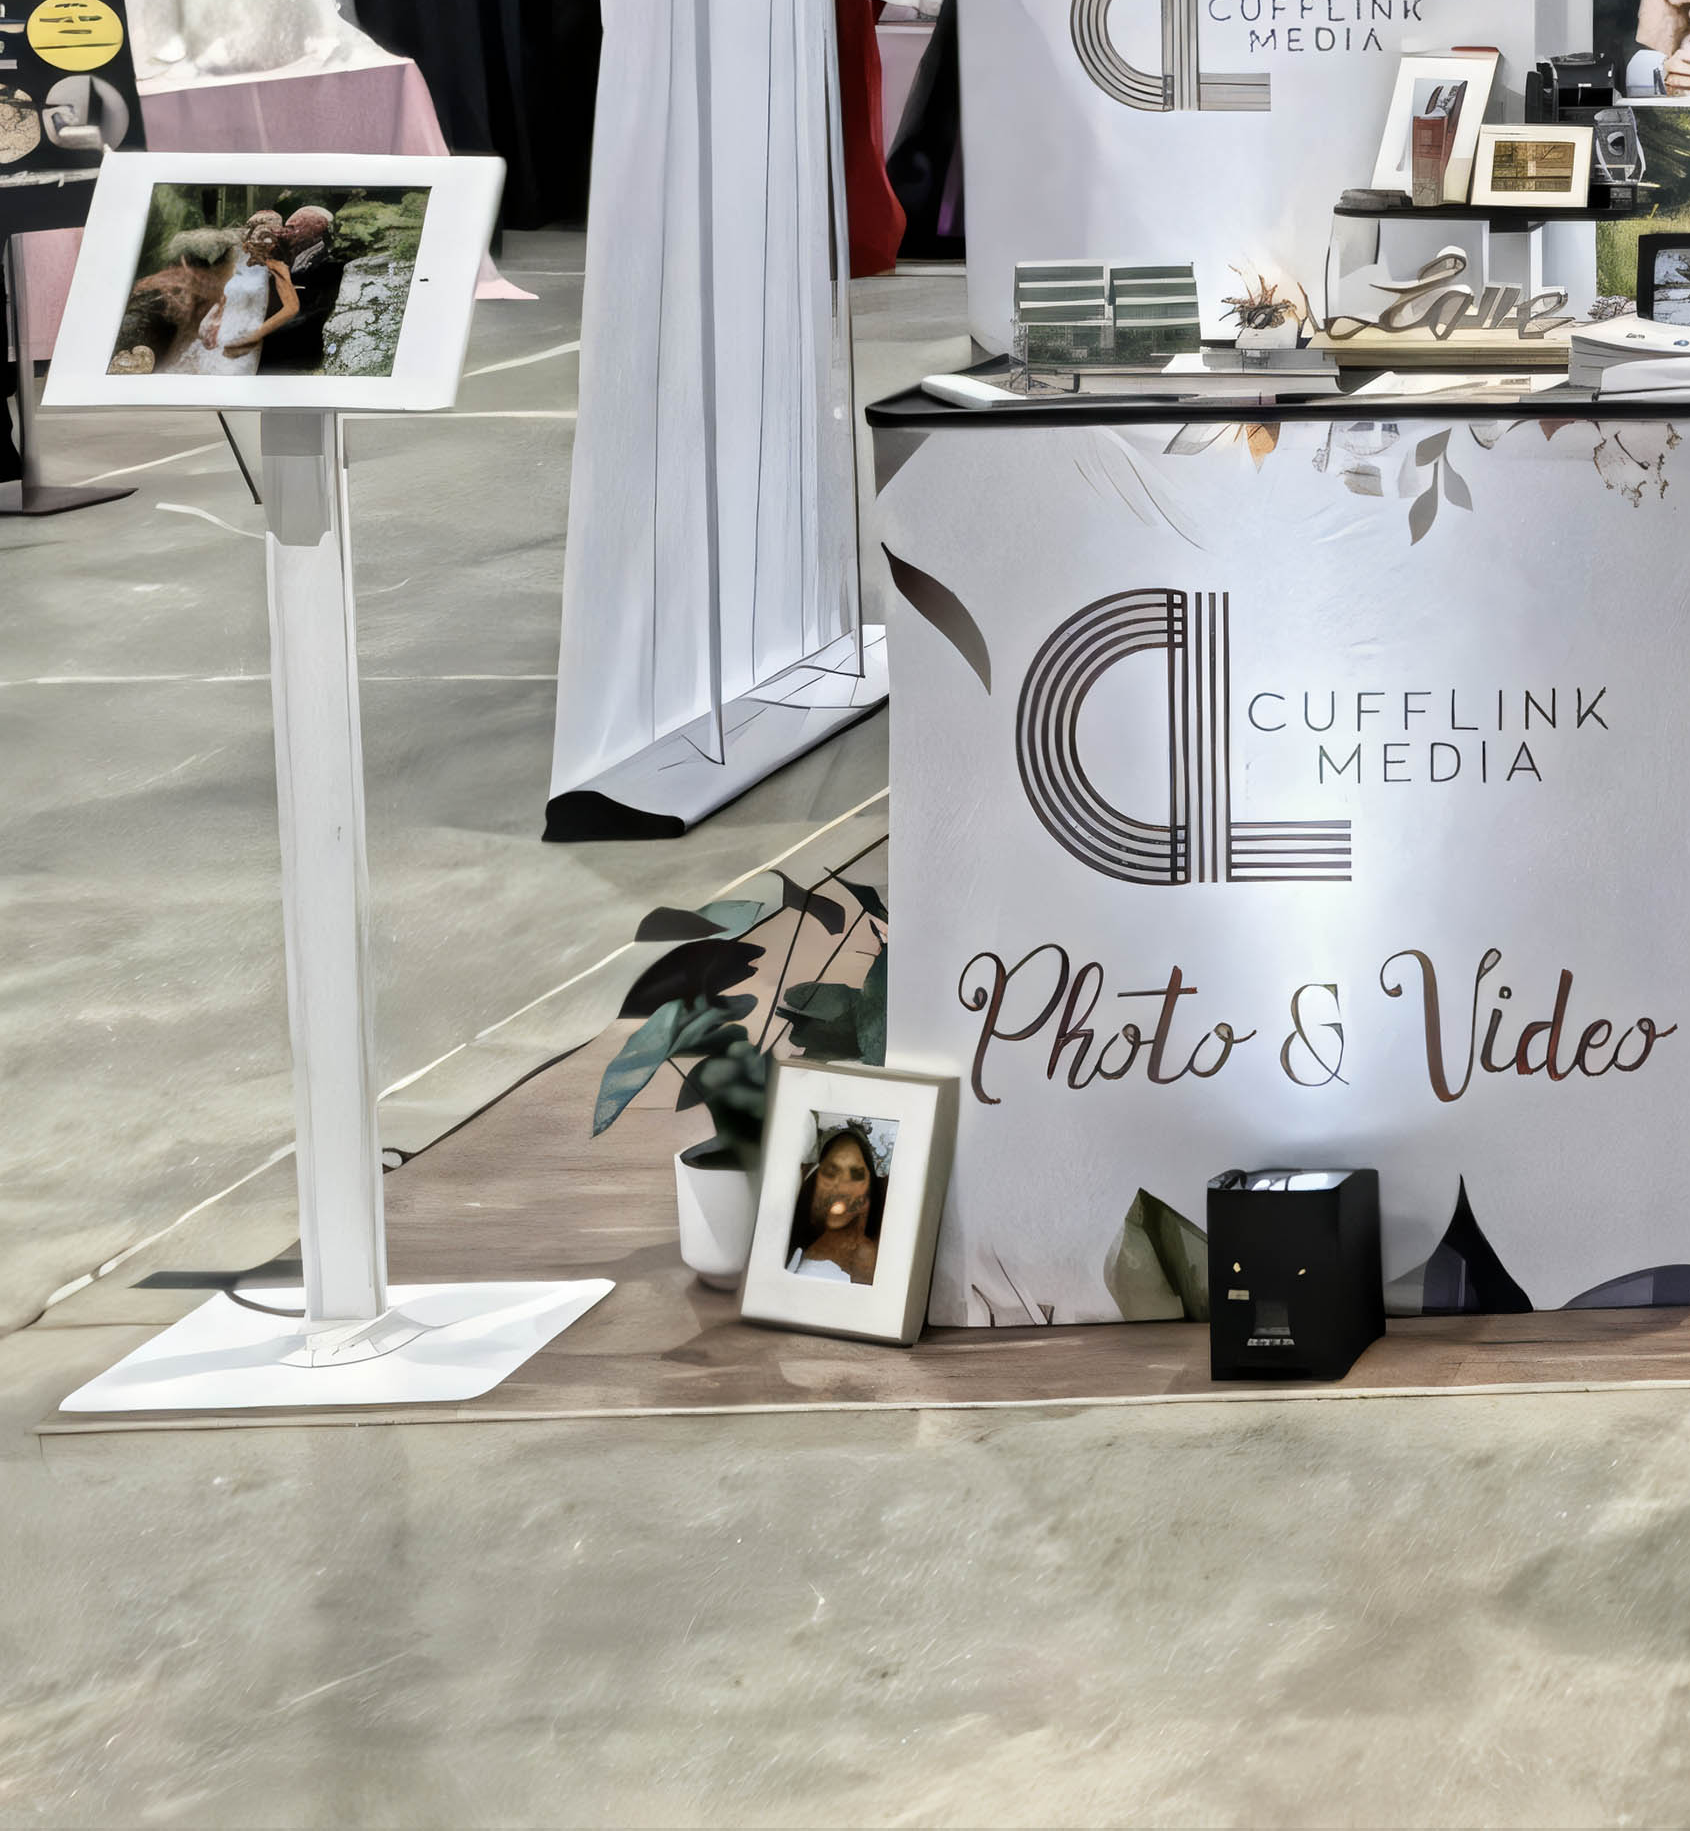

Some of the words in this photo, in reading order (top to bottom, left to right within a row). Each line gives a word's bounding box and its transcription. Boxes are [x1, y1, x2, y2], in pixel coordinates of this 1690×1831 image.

[1249, 27, 1384, 53] MEDIA
[1248, 686, 1610, 732] CUFFLINK
[1318, 739, 1543, 785] MEDIA
[959, 944, 1257, 1105] Photo
[1280, 984, 1350, 1087] &
[1380, 948, 1678, 1102] Video
